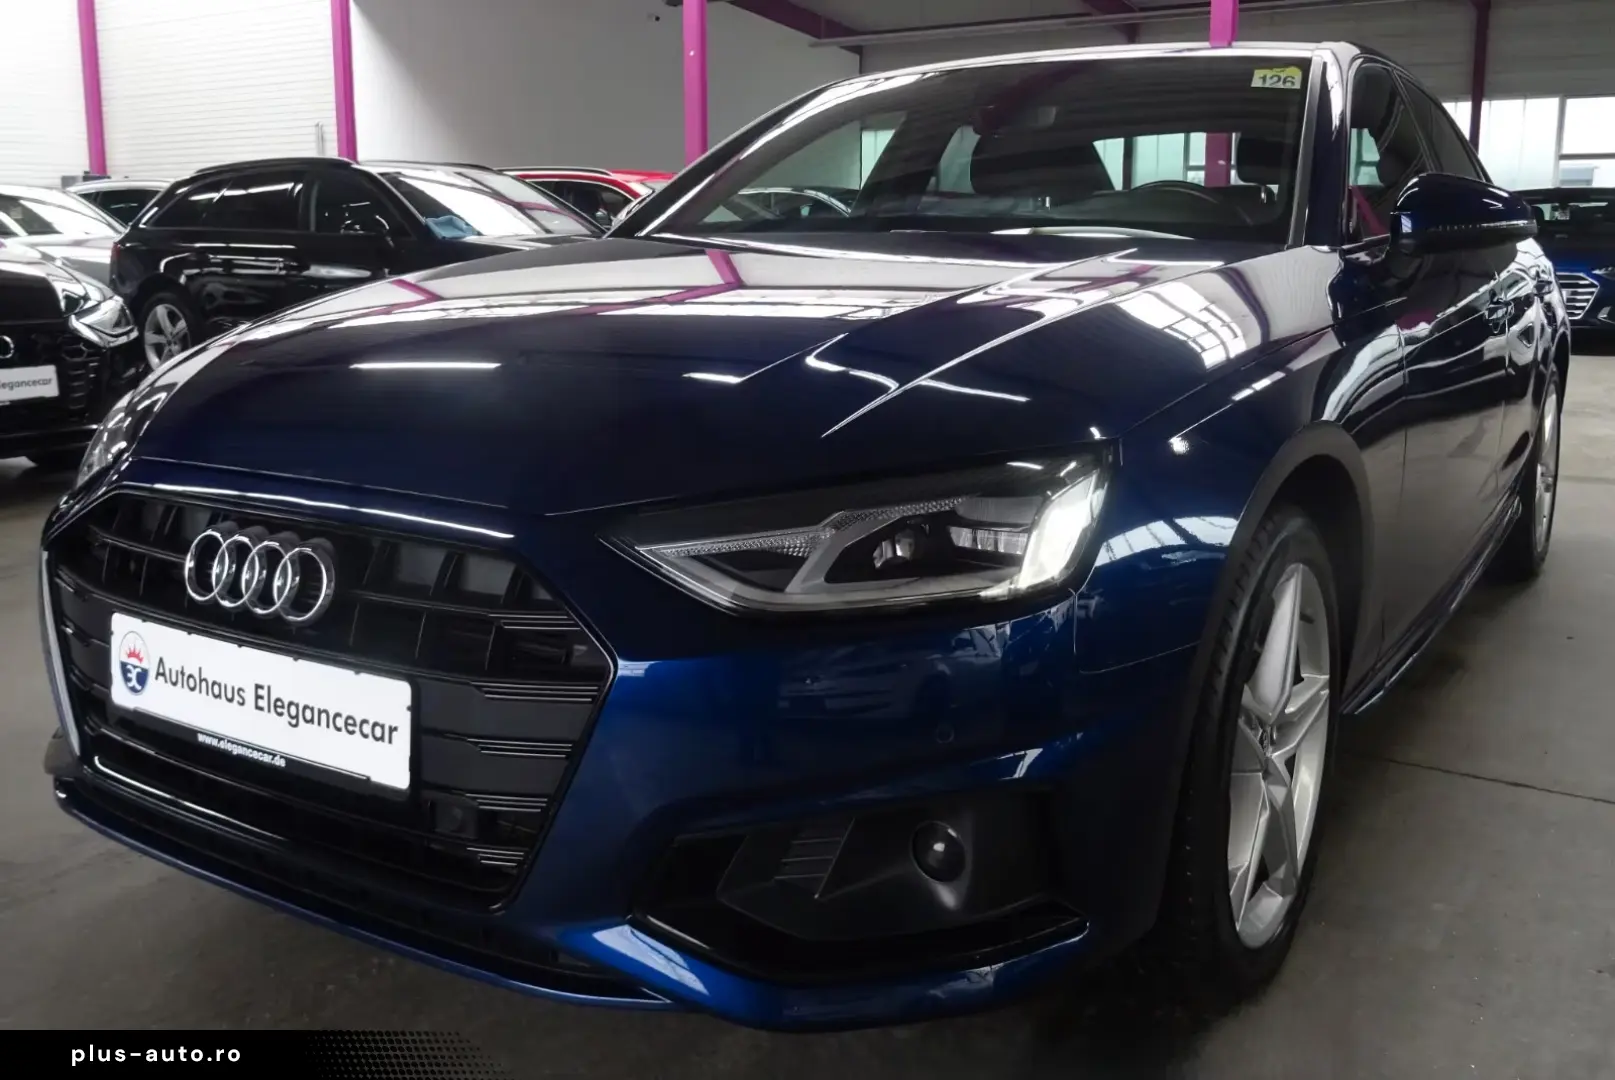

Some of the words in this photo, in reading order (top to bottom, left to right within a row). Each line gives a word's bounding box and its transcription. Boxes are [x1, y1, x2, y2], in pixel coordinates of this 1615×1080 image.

[1258, 74, 1296, 87] 126
[155, 656, 246, 706] Autohaus
[254, 683, 399, 745] Elegancecar
[197, 732, 286, 767] www.elegancecar.de
